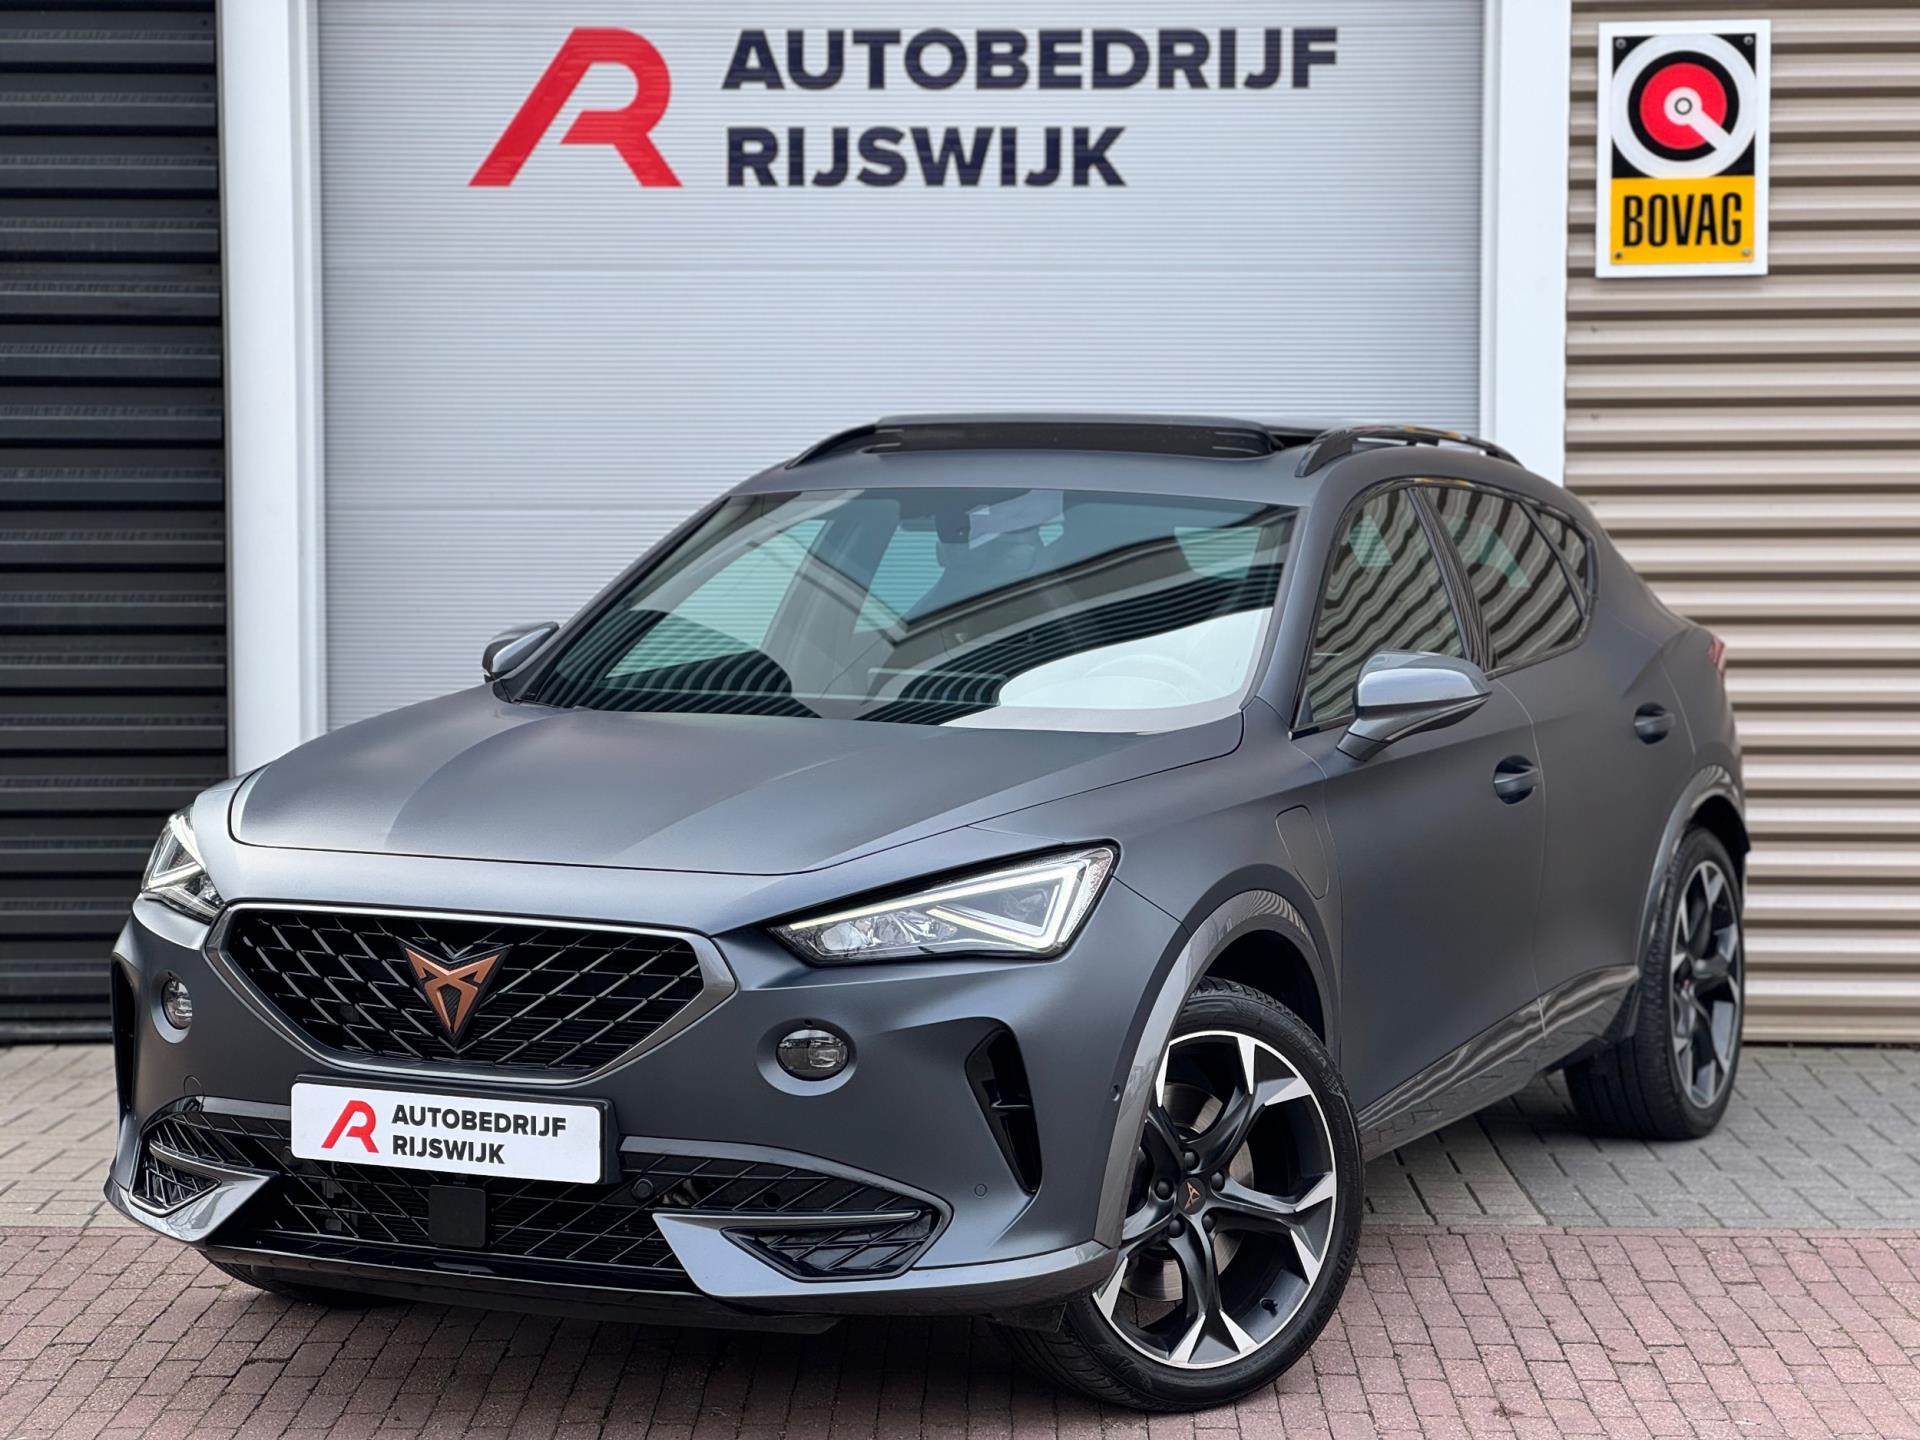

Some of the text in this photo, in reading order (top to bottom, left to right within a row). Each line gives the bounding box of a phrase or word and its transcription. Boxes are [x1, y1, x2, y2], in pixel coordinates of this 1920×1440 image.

[722, 28, 1338, 90] AUTOBEDRIJF
[727, 126, 1126, 187] RIJSWIJK
[1623, 192, 1742, 247] BOVAG
[391, 1104, 566, 1137] AUTOBEDRIJF
[392, 1135, 505, 1165] RIJSWIJK
